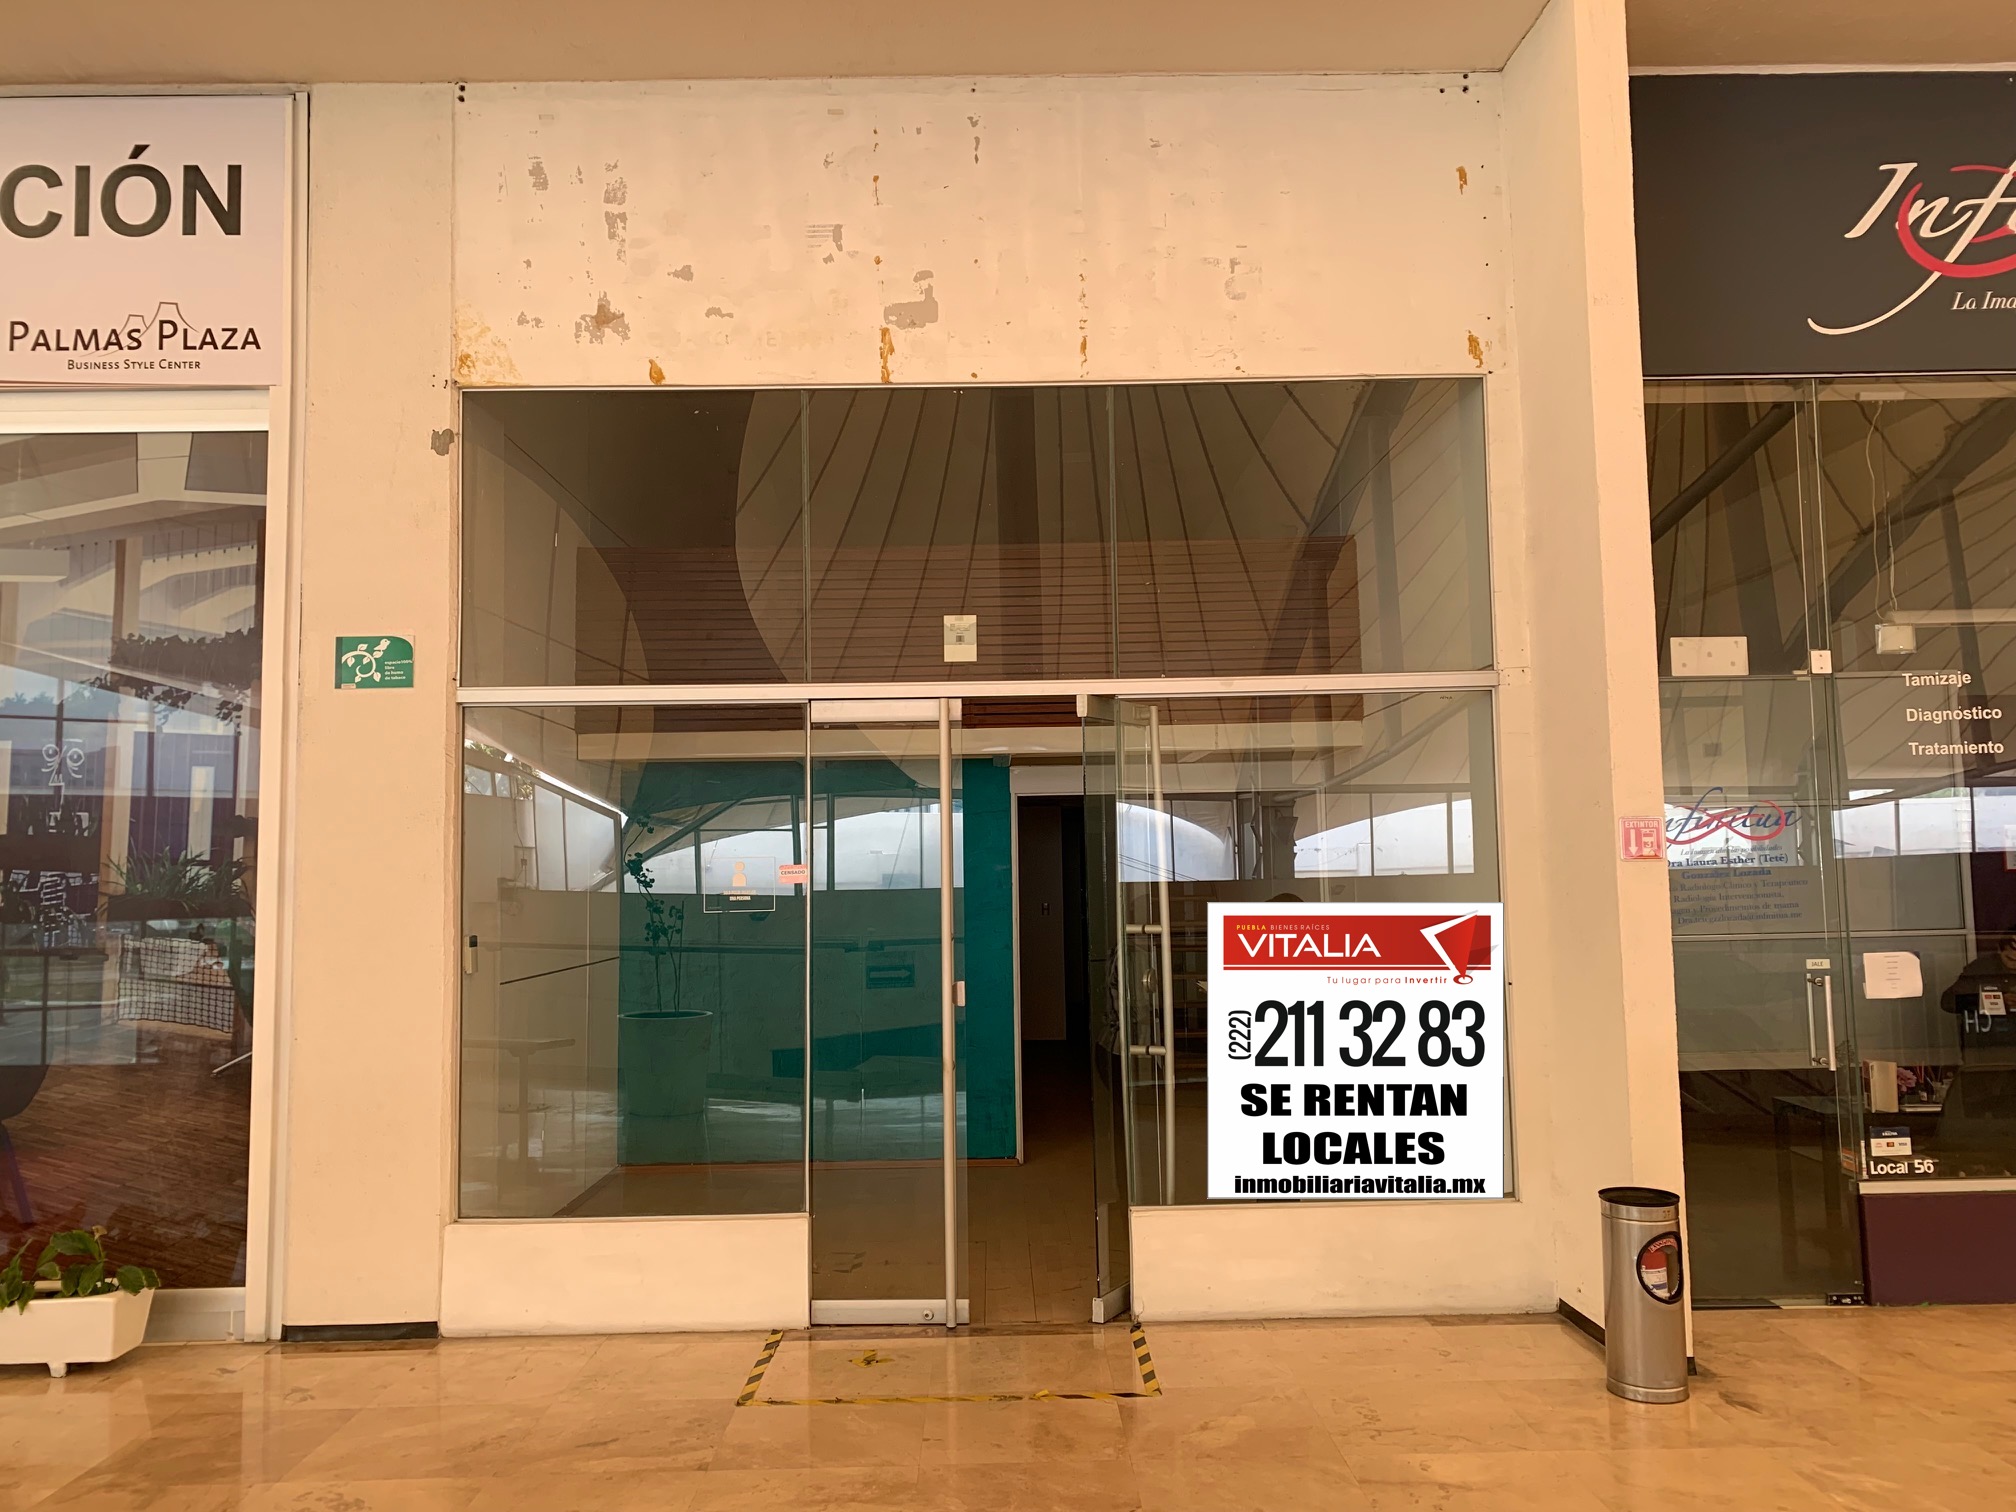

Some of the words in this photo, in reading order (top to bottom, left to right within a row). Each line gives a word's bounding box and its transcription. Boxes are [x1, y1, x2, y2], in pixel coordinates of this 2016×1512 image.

[0, 144, 242, 238] CIÓN
[1951, 291, 1976, 310] La
[1901, 671, 1972, 687] Tamizaje
[1906, 706, 2003, 724] Diagnóstico
[1908, 741, 2004, 756] Tratamiento
[1625, 820, 1659, 828] EXTINTOR
[1686, 857, 1718, 867] Laura
[1720, 855, 1756, 865] Esther
[1870, 1161, 1908, 1175] Local
[1914, 1159, 1935, 1174] 56
